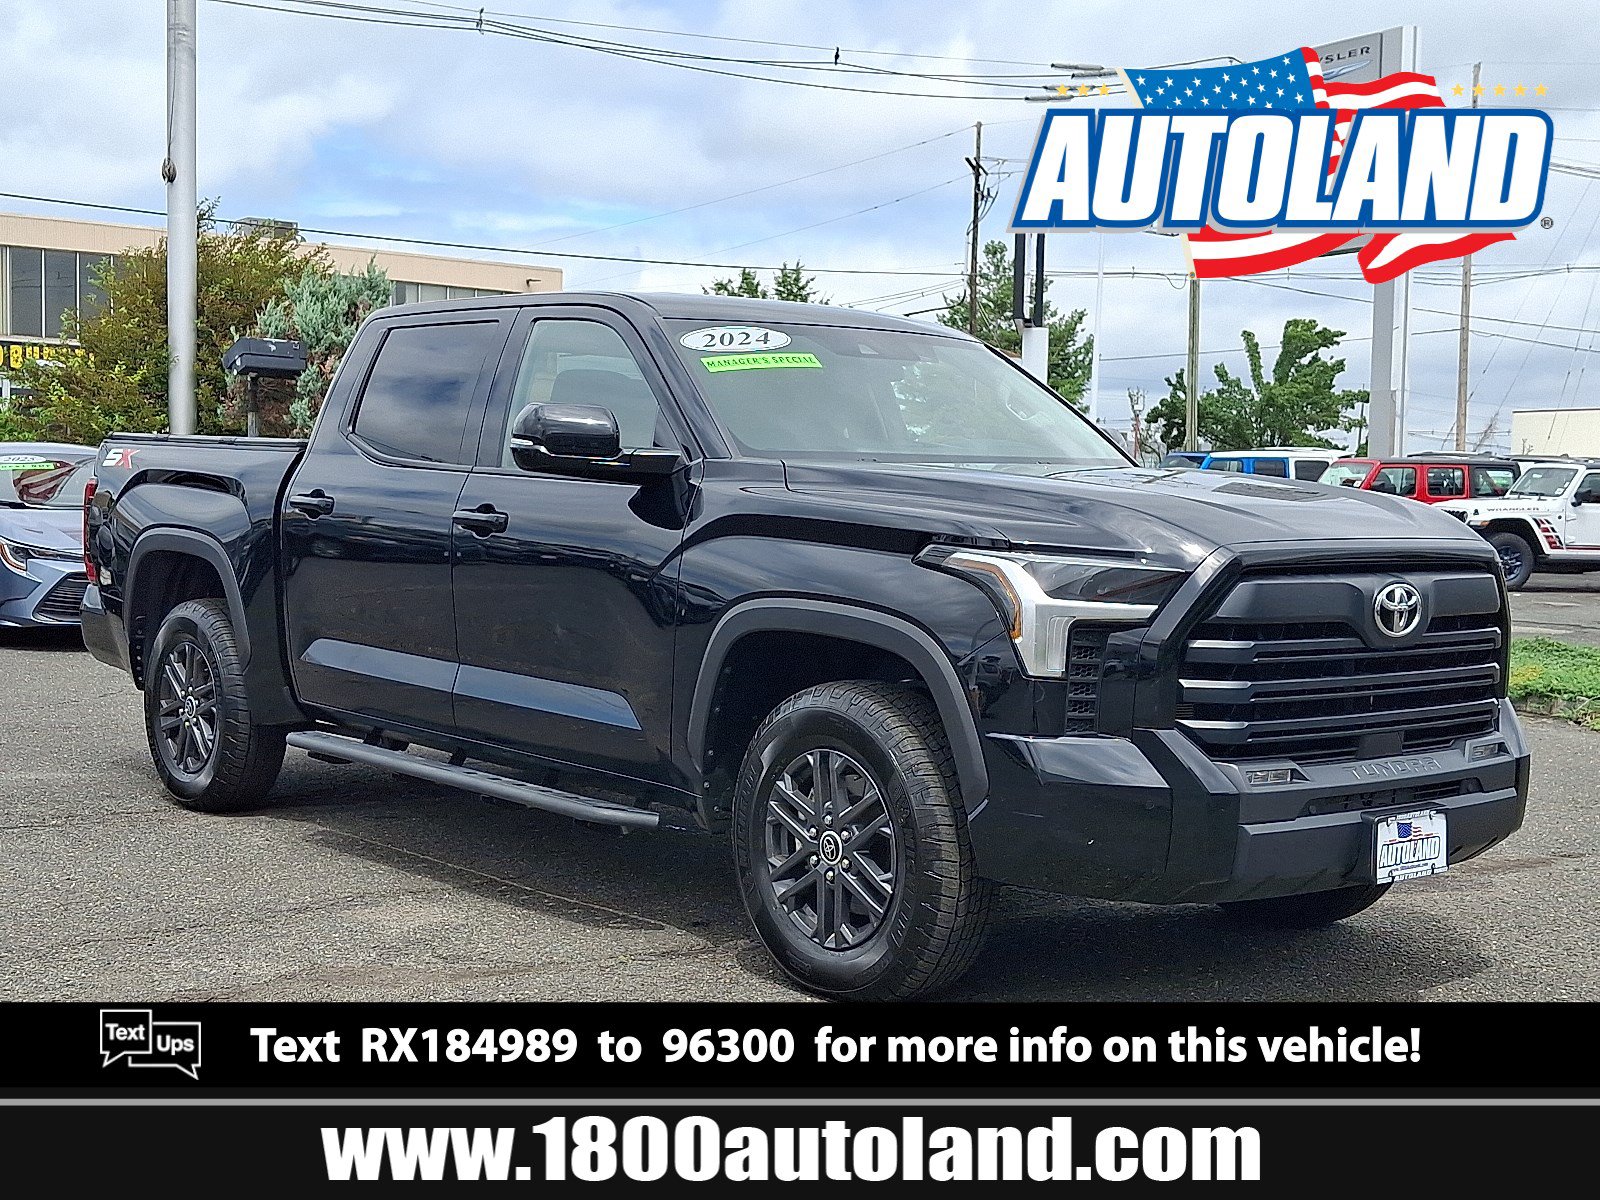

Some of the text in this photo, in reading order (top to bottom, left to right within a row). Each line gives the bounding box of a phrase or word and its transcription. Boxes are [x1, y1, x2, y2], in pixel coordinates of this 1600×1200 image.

[701, 331, 771, 348] 2024
[706, 355, 817, 368] MANAGER'S SPECIAL
[1342, 756, 1442, 780] TUNDRA
[1379, 836, 1440, 869] AUTOLAND
